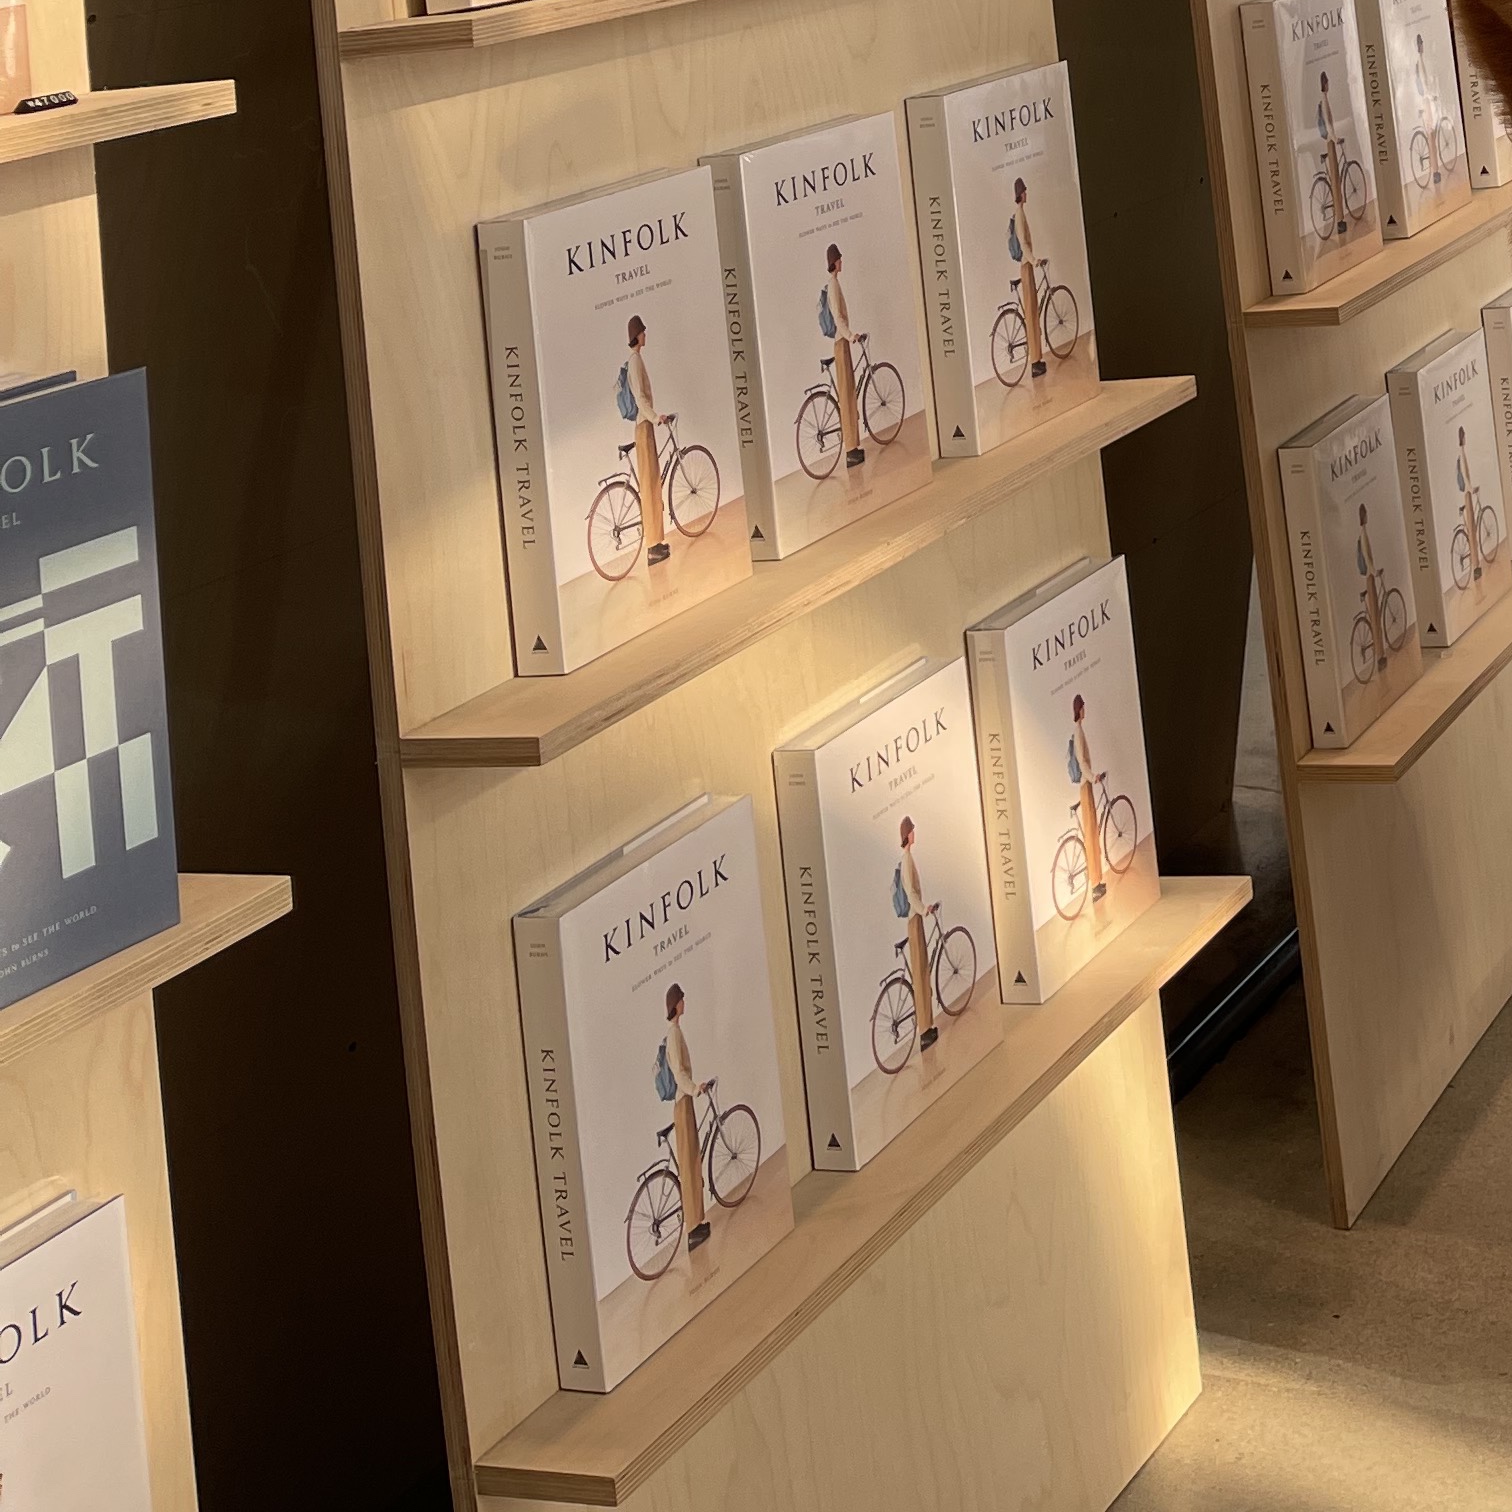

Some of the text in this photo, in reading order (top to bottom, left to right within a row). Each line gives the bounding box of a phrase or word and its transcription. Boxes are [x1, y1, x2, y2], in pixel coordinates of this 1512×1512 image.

[1291, 6, 1344, 42] KINFOLK
[972, 97, 1054, 143] KINFOLK
[1365, 44, 1389, 166] KINFOLK TRAVEL
[1469, 73, 1482, 119] TRAVEL
[774, 151, 877, 207] KINFOLK
[1260, 83, 1285, 216] KINFOLK TRAVEL
[814, 197, 845, 217] TRAVEL
[566, 211, 689, 276] KINFOLK
[615, 264, 650, 285] TRAVEL
[929, 195, 956, 358] KINFOLK TRAVEL
[724, 267, 754, 449] KINFOLK TRAVEL
[1433, 358, 1479, 404] KINFOLK
[504, 346, 536, 550] KINFOLK TRAVEL
[1329, 427, 1383, 482] KINFOLK
[1406, 448, 1430, 572] KINFOLK TRAVEL
[1300, 529, 1325, 666] KINFOLK TRAVEL
[1031, 599, 1111, 671] KINFOLK
[849, 706, 948, 793] KINFOLK
[989, 733, 1016, 900] KINFOLK TRAVEL
[42, 922, 60, 937] THE
[64, 906, 97, 925] WORLD
[602, 853, 729, 963] KINFOLK
[653, 924, 690, 957] TRAVEL
[21, 948, 49, 967] BURNS
[800, 866, 830, 1055] KINFOLK TRAVEL
[541, 1048, 575, 1261] KINFOLK TRAVEL
